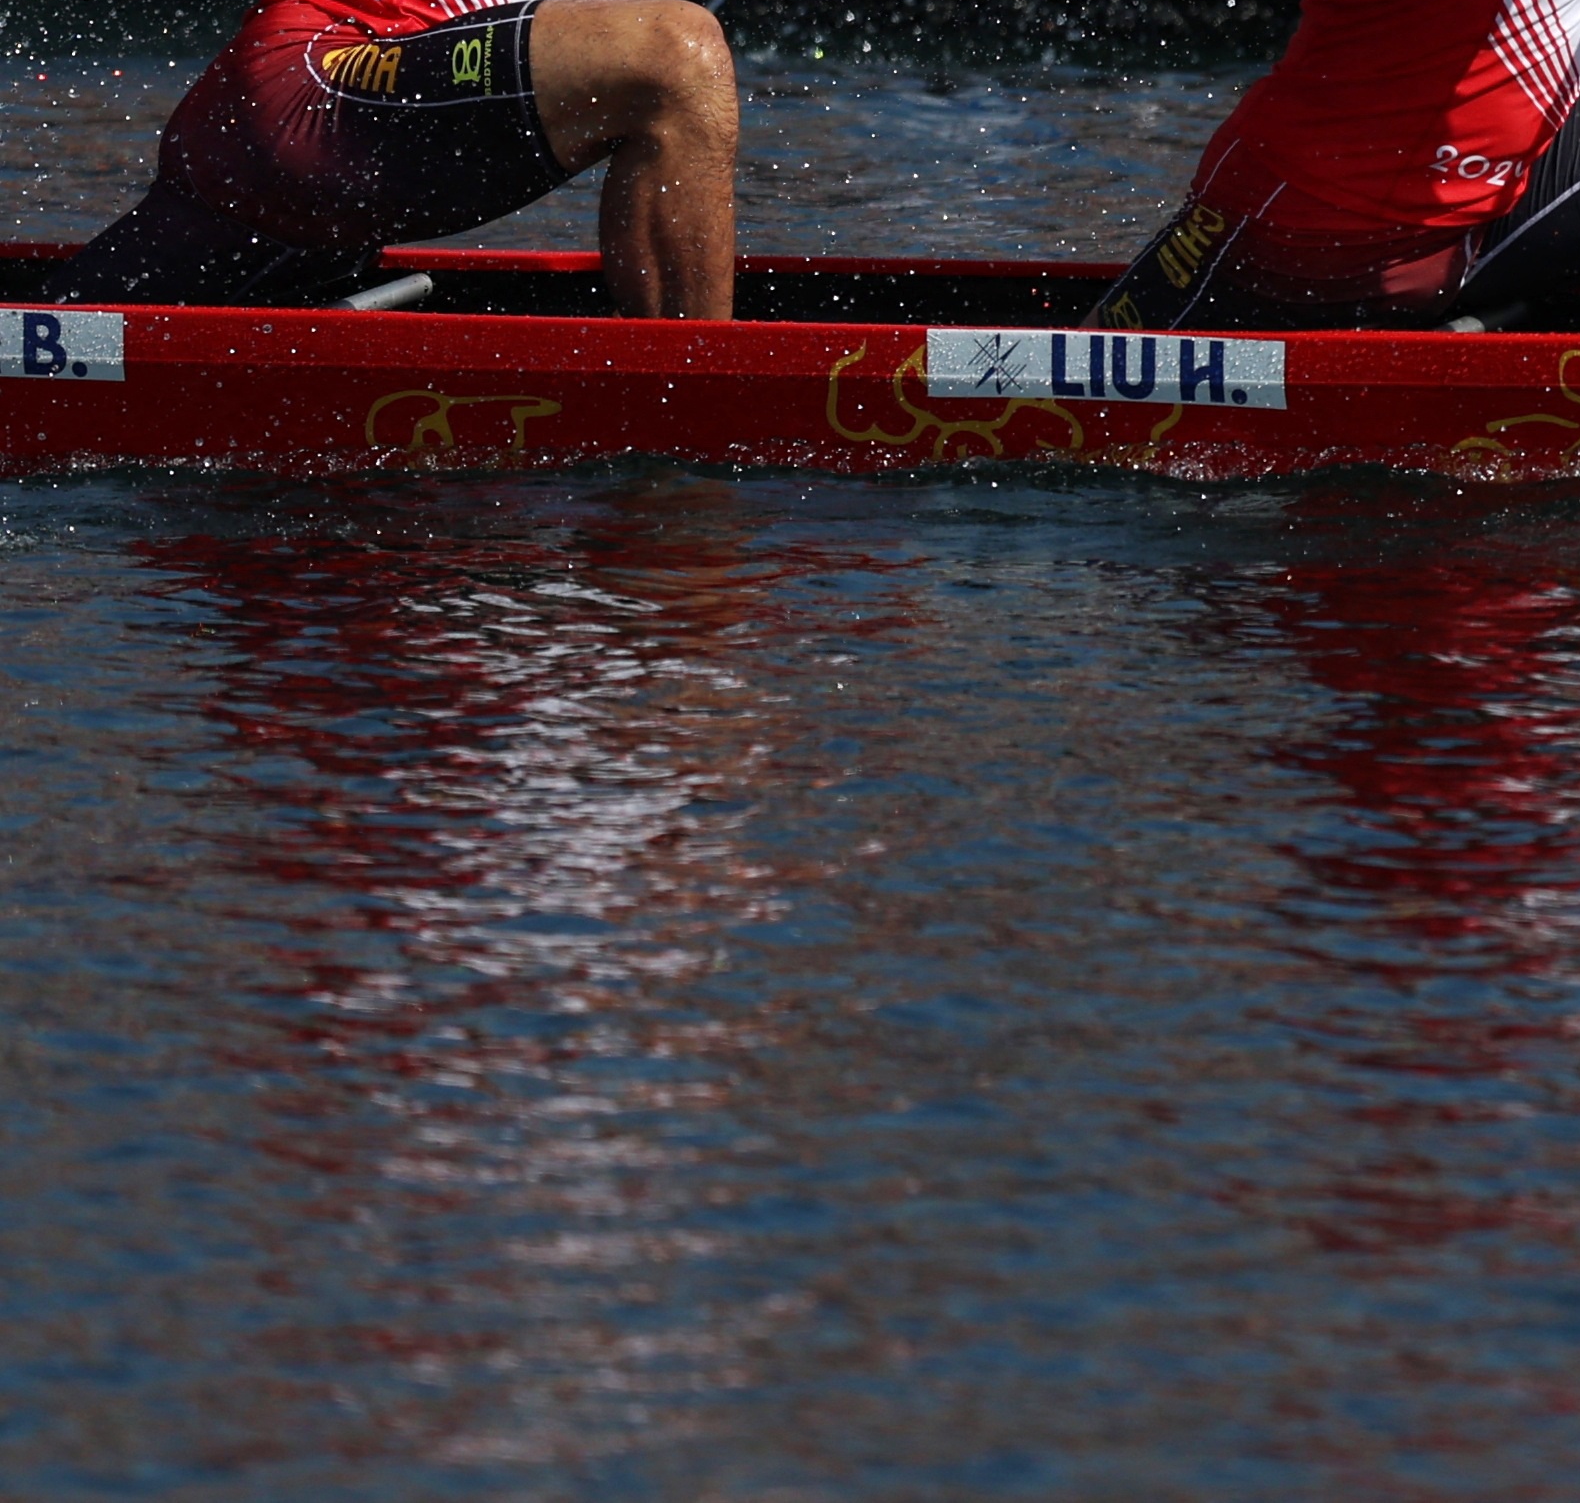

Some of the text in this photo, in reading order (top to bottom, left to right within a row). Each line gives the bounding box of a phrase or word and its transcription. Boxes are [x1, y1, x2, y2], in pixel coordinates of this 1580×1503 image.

[23, 311, 88, 378] B.
[1051, 333, 1249, 406] LIU H.
